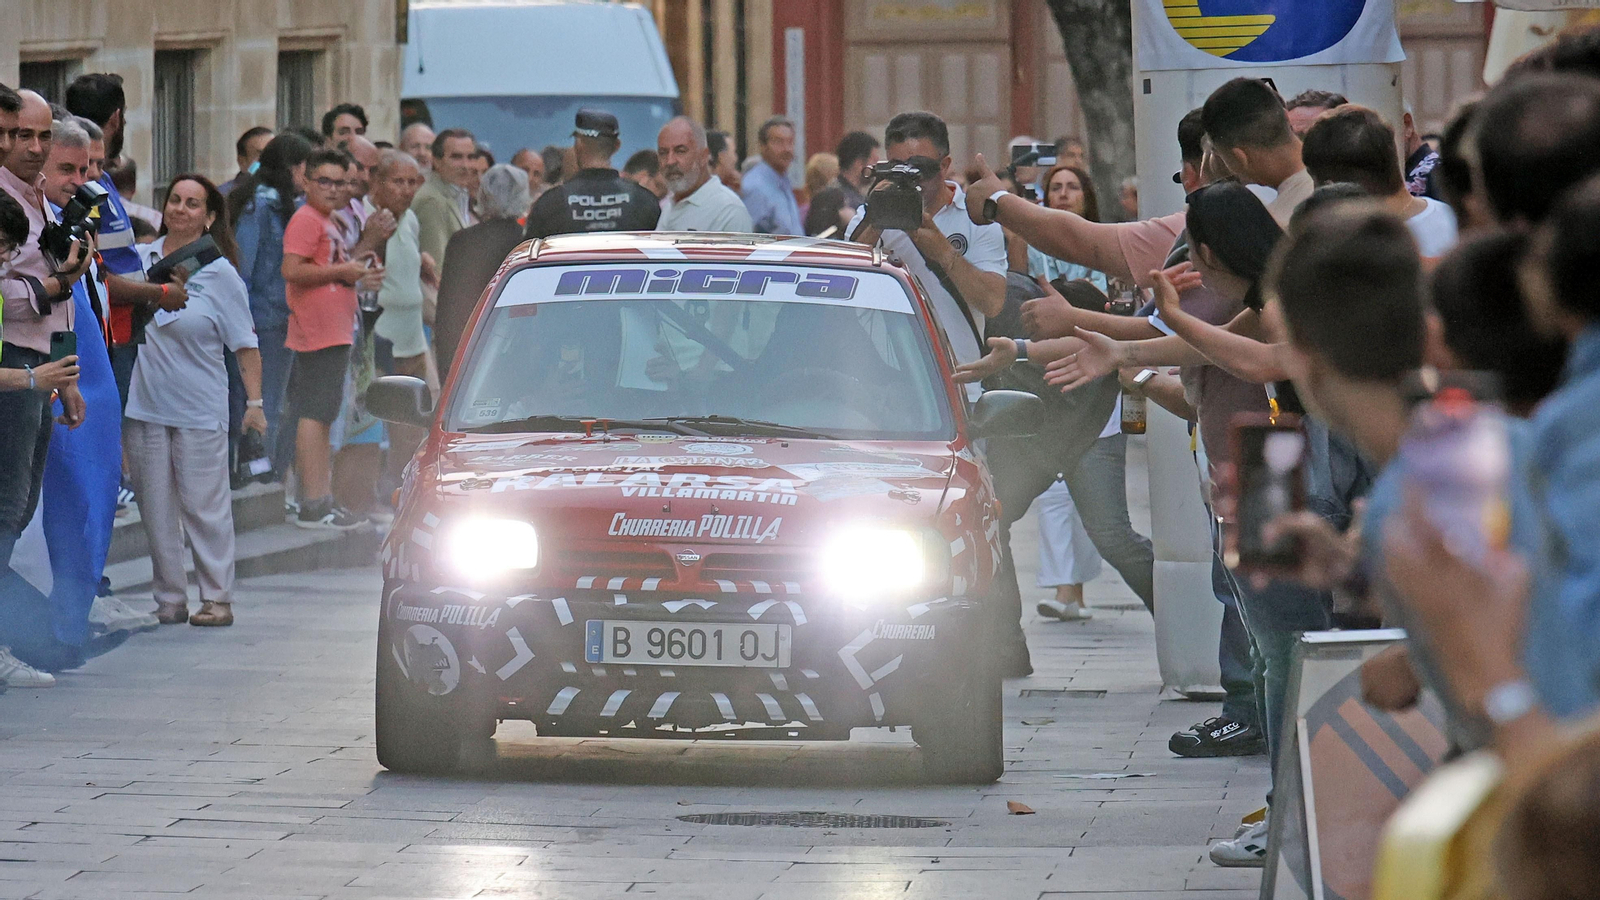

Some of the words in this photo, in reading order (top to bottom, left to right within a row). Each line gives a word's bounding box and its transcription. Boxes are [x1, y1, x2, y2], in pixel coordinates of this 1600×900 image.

[568, 193, 630, 206] POLICIA
[554, 268, 859, 300] micra
[621, 486, 799, 506] VILLAMARTIN
[608, 512, 696, 537] CHURRERIA
[697, 514, 783, 544] POLILLA
[438, 604, 502, 630] POLILLA
[872, 618, 936, 640] CHURRERIA
[592, 645, 600, 655] E
[612, 626, 632, 658] B
[646, 627, 723, 661] 9601
